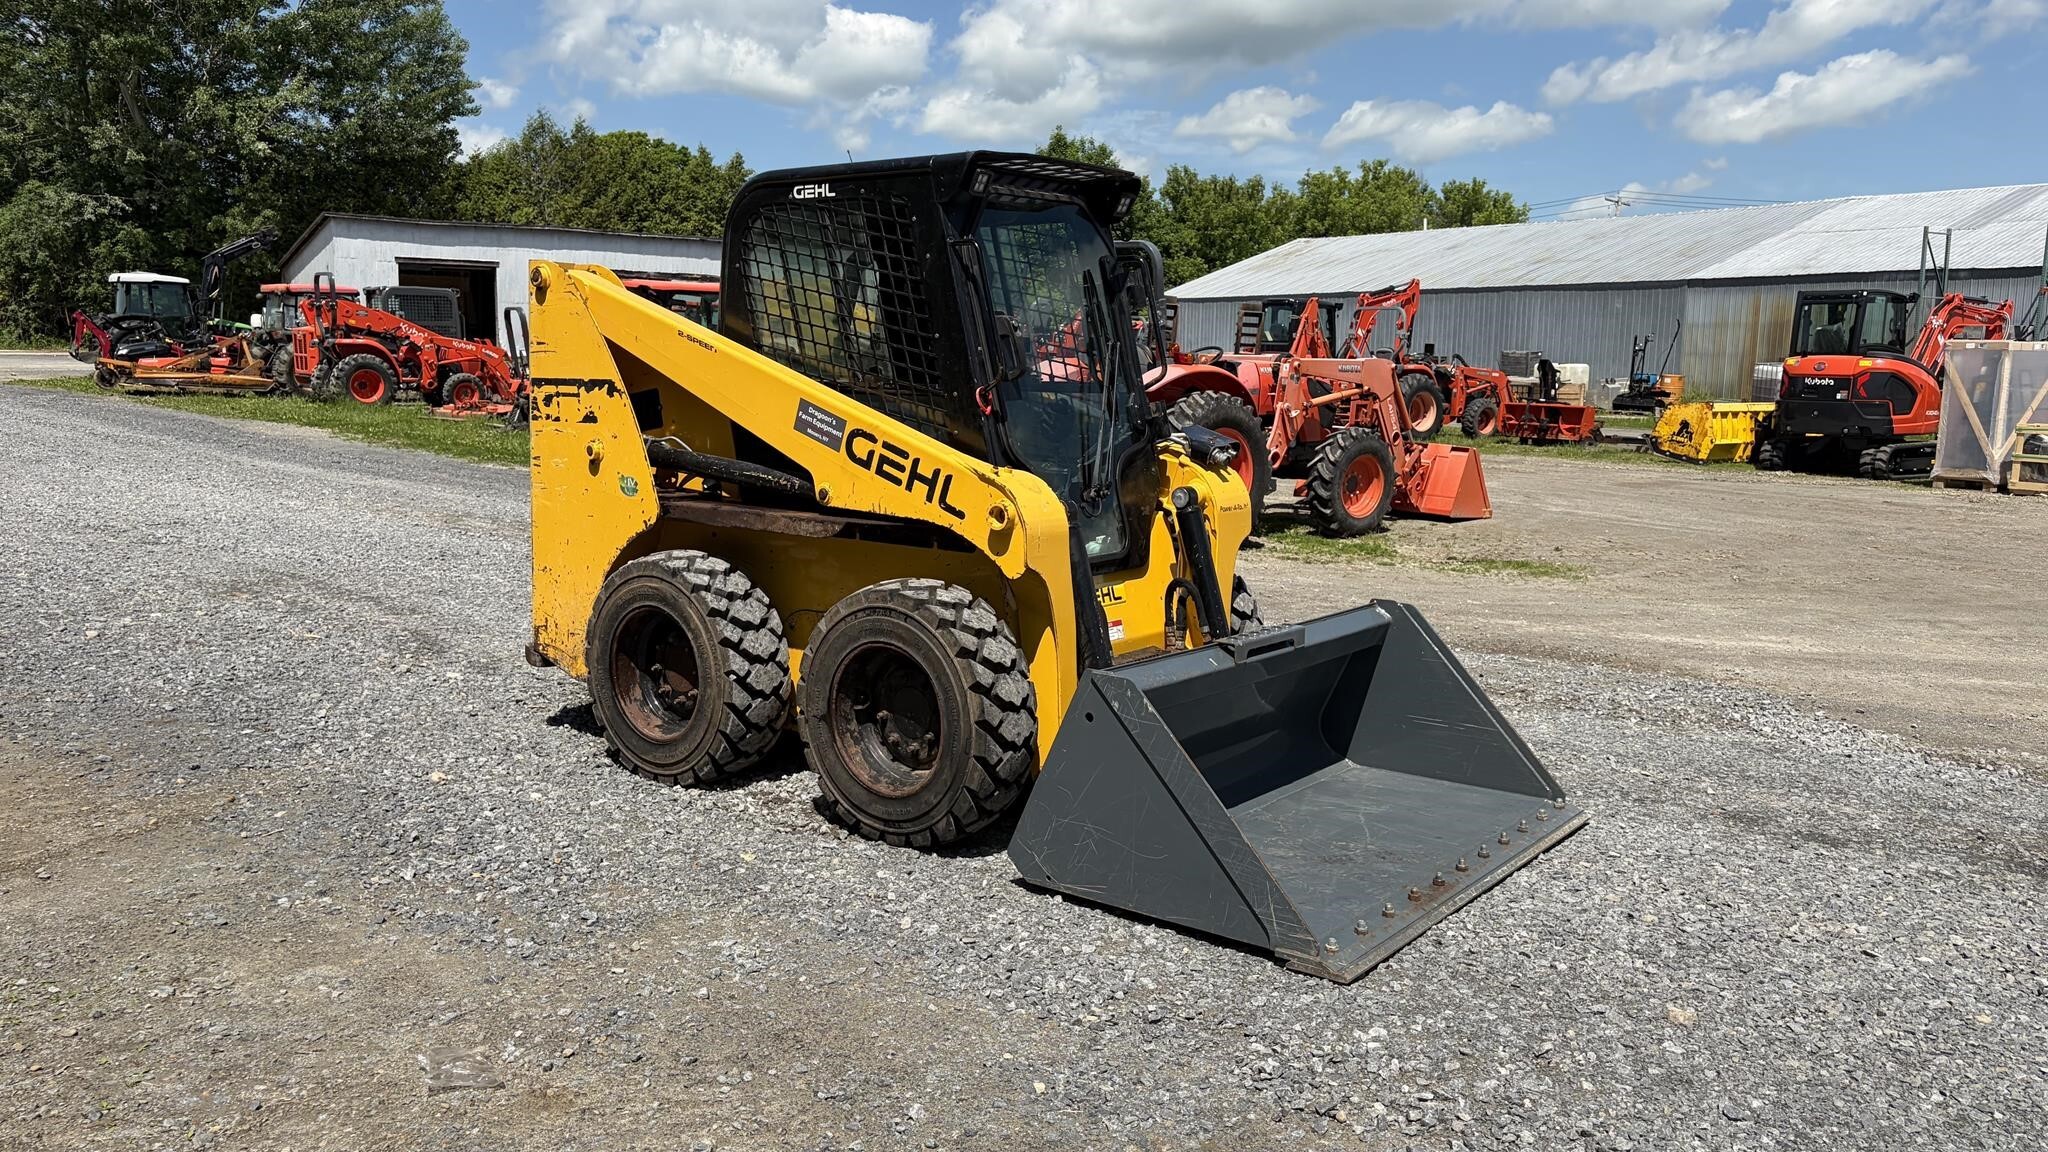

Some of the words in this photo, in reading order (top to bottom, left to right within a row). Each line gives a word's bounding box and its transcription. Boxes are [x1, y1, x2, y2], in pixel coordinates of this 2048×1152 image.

[793, 183, 836, 199] GEHL
[1338, 364, 1361, 373] KUBOTA
[1804, 377, 1835, 386] Kubota
[798, 411, 813, 423] Farm
[812, 418, 843, 438] Equipment
[808, 406, 836, 425] Dragoon's
[845, 428, 966, 520] GEHL
[1096, 585, 1123, 604] EHL
